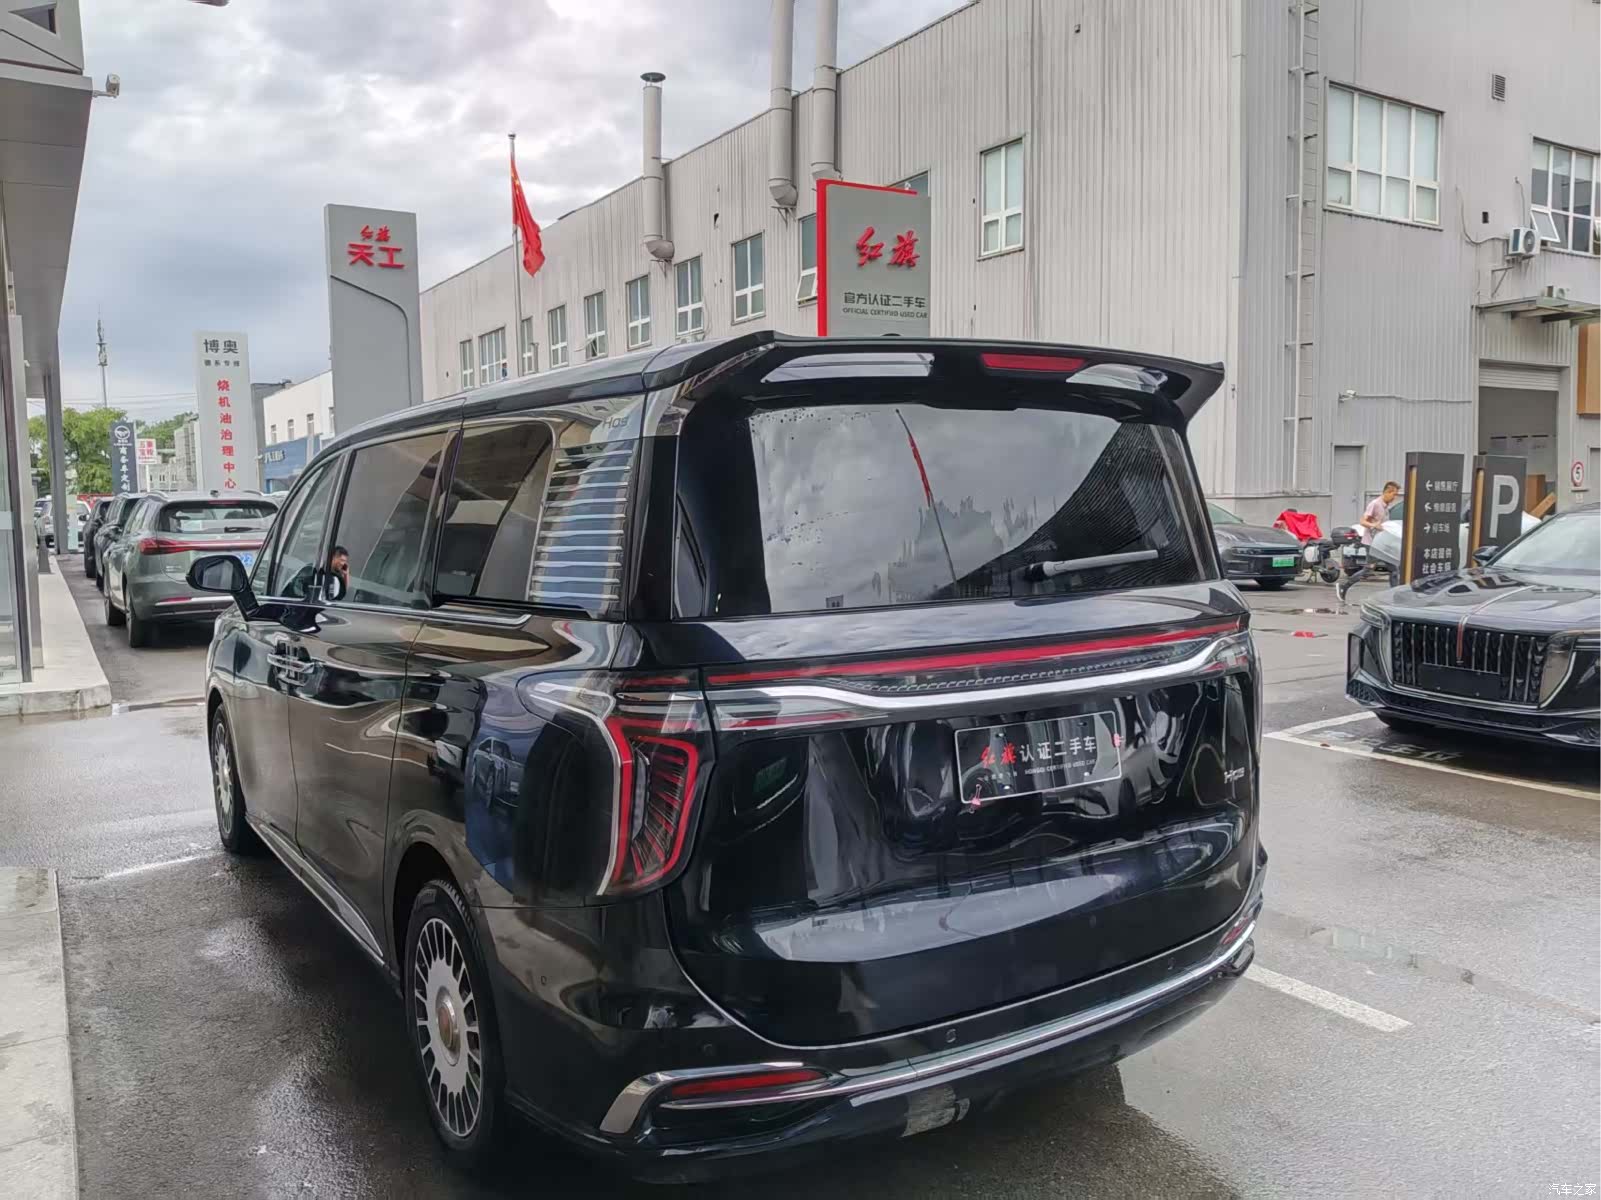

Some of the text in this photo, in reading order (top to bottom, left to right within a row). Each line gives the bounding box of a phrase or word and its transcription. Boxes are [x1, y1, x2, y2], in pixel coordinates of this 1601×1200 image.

[360, 225, 391, 242] 红旗
[347, 243, 405, 269] 天工
[856, 226, 920, 268] 红旗
[842, 307, 869, 315] OFFICIAL
[870, 308, 899, 317] CERTIFIED
[843, 292, 926, 308] 官方认证二手车
[203, 339, 239, 354] 博奥
[217, 379, 237, 489] 烧机油治理中心
[1489, 474, 1520, 538] P
[980, 736, 1097, 768] 红旗 认证二手车
